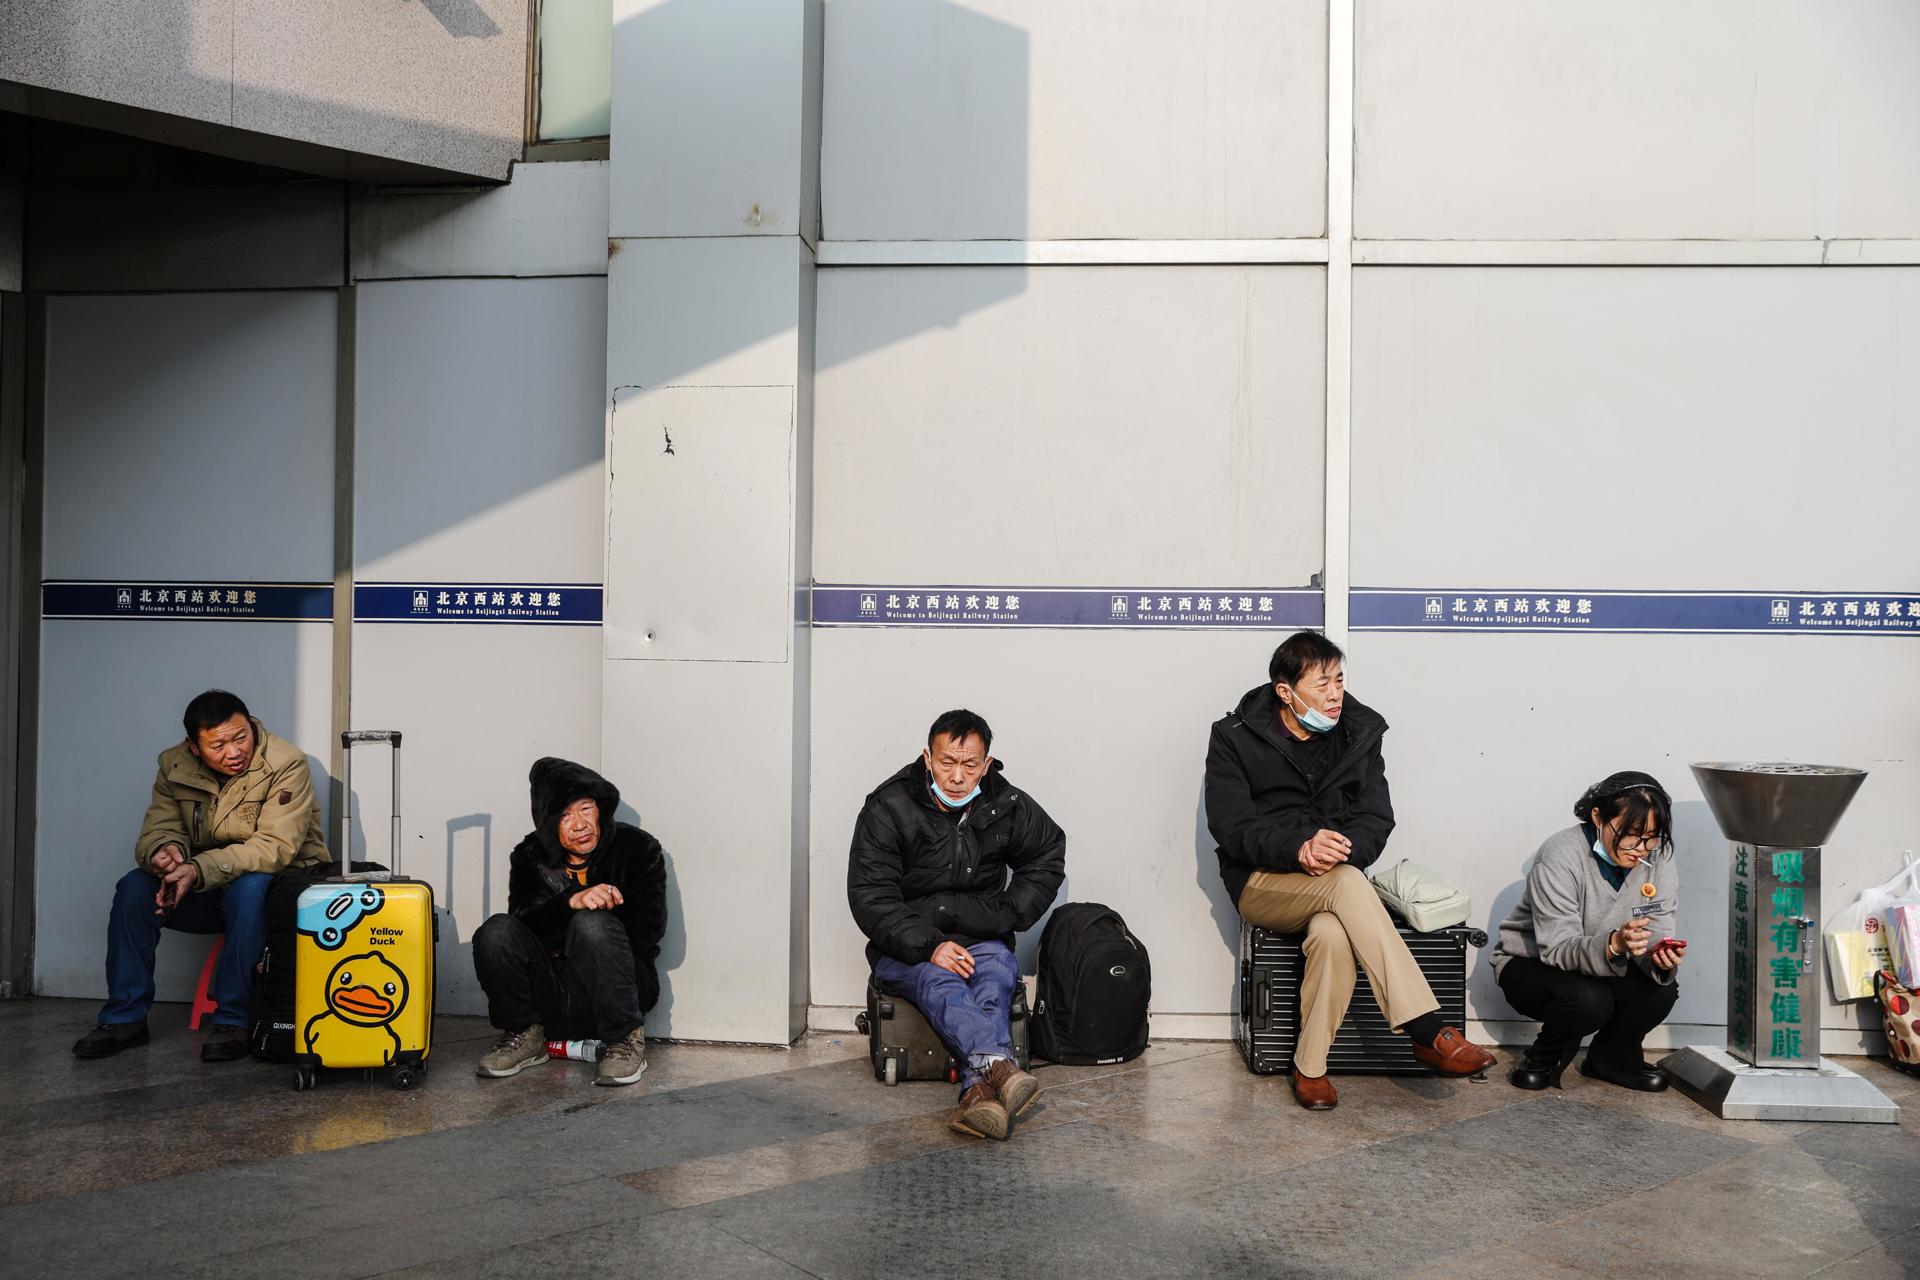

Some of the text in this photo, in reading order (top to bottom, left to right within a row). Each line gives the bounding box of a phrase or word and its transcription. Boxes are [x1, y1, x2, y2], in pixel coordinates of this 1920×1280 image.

[139, 589, 257, 604] 北京西站欢迎您
[436, 591, 561, 607] 北京西站欢迎您
[886, 594, 1020, 610] 北京西站欢迎您
[1137, 596, 1273, 612] 北京西站欢迎您
[1452, 597, 1592, 614] 北京西站欢迎您
[437, 607, 464, 615] Welcome
[508, 608, 533, 617] Railway
[886, 611, 915, 619] Welcome
[963, 612, 990, 621] Railway
[993, 612, 1018, 620] Station
[1138, 613, 1168, 621] Welcome
[1215, 614, 1243, 623] Railway
[1532, 616, 1561, 625] Railway
[1799, 618, 1832, 626] Welcome
[1883, 619, 1913, 628] Railway
[370, 927, 404, 936] Yellow
[370, 937, 396, 945] Duck
[1733, 846, 1748, 1053] 注意消防安全
[1769, 851, 1805, 1060] 吸烟有害健康
